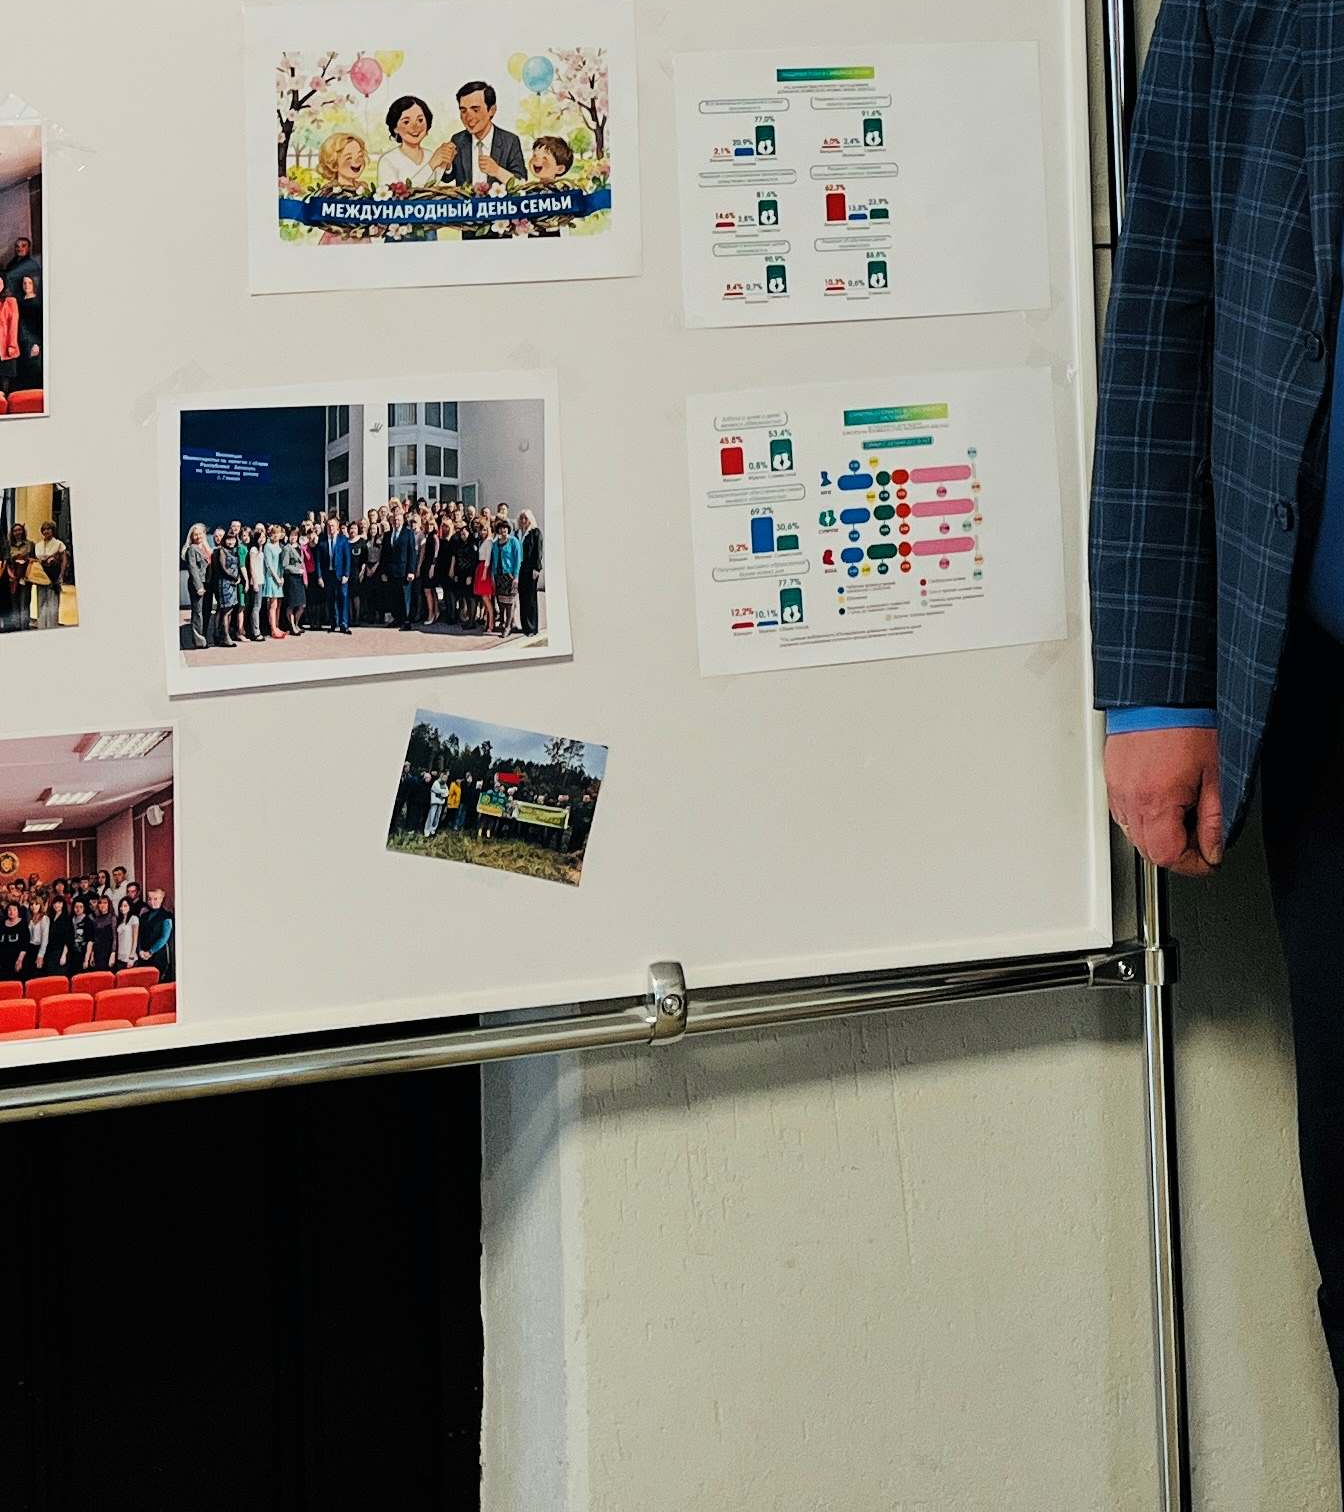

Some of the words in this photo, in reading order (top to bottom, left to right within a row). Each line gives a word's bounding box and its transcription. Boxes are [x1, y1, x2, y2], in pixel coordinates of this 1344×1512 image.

[321, 199, 473, 221] МЕЖДУНАРОДНЫЙ
[476, 199, 518, 219] ДЕНЬ
[520, 195, 572, 214] СЕМЬИ
